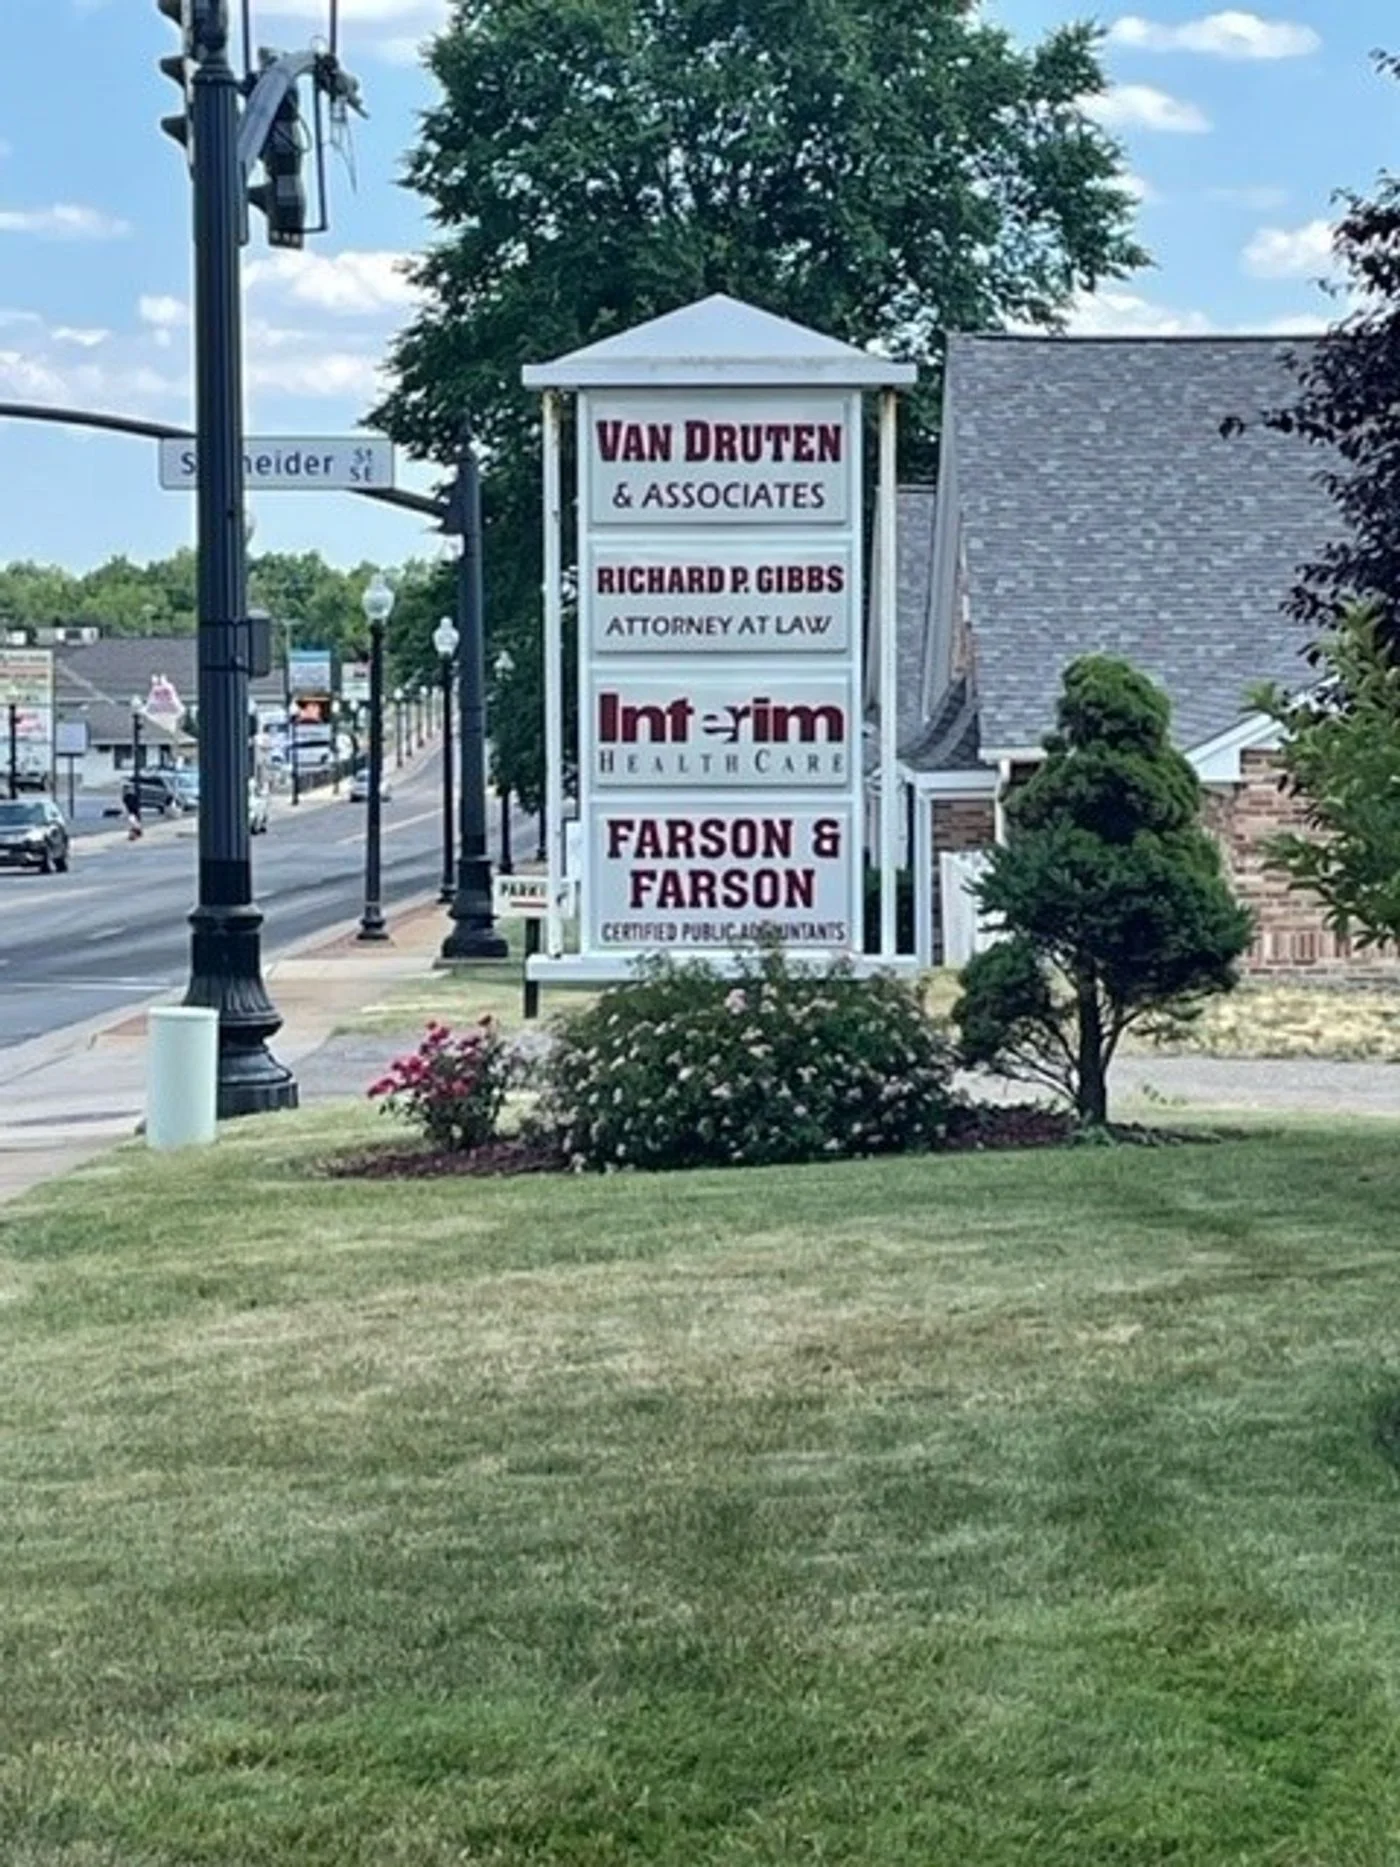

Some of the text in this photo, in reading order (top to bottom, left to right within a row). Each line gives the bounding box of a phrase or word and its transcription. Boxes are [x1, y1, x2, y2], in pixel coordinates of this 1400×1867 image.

[596, 419, 842, 462] VAN DRUTEN
[181, 449, 334, 476] Sneider
[612, 482, 825, 508] & ASSOCIATES
[597, 566, 844, 594] RICHARD P. GIBBS
[606, 616, 832, 636] ATTORNEY AT LAW
[598, 692, 844, 743] Interim
[607, 818, 841, 859] FARSON &
[629, 869, 815, 909] FARSON
[601, 922, 678, 941] CERTIFIED
[682, 922, 735, 941] PUBLIC
